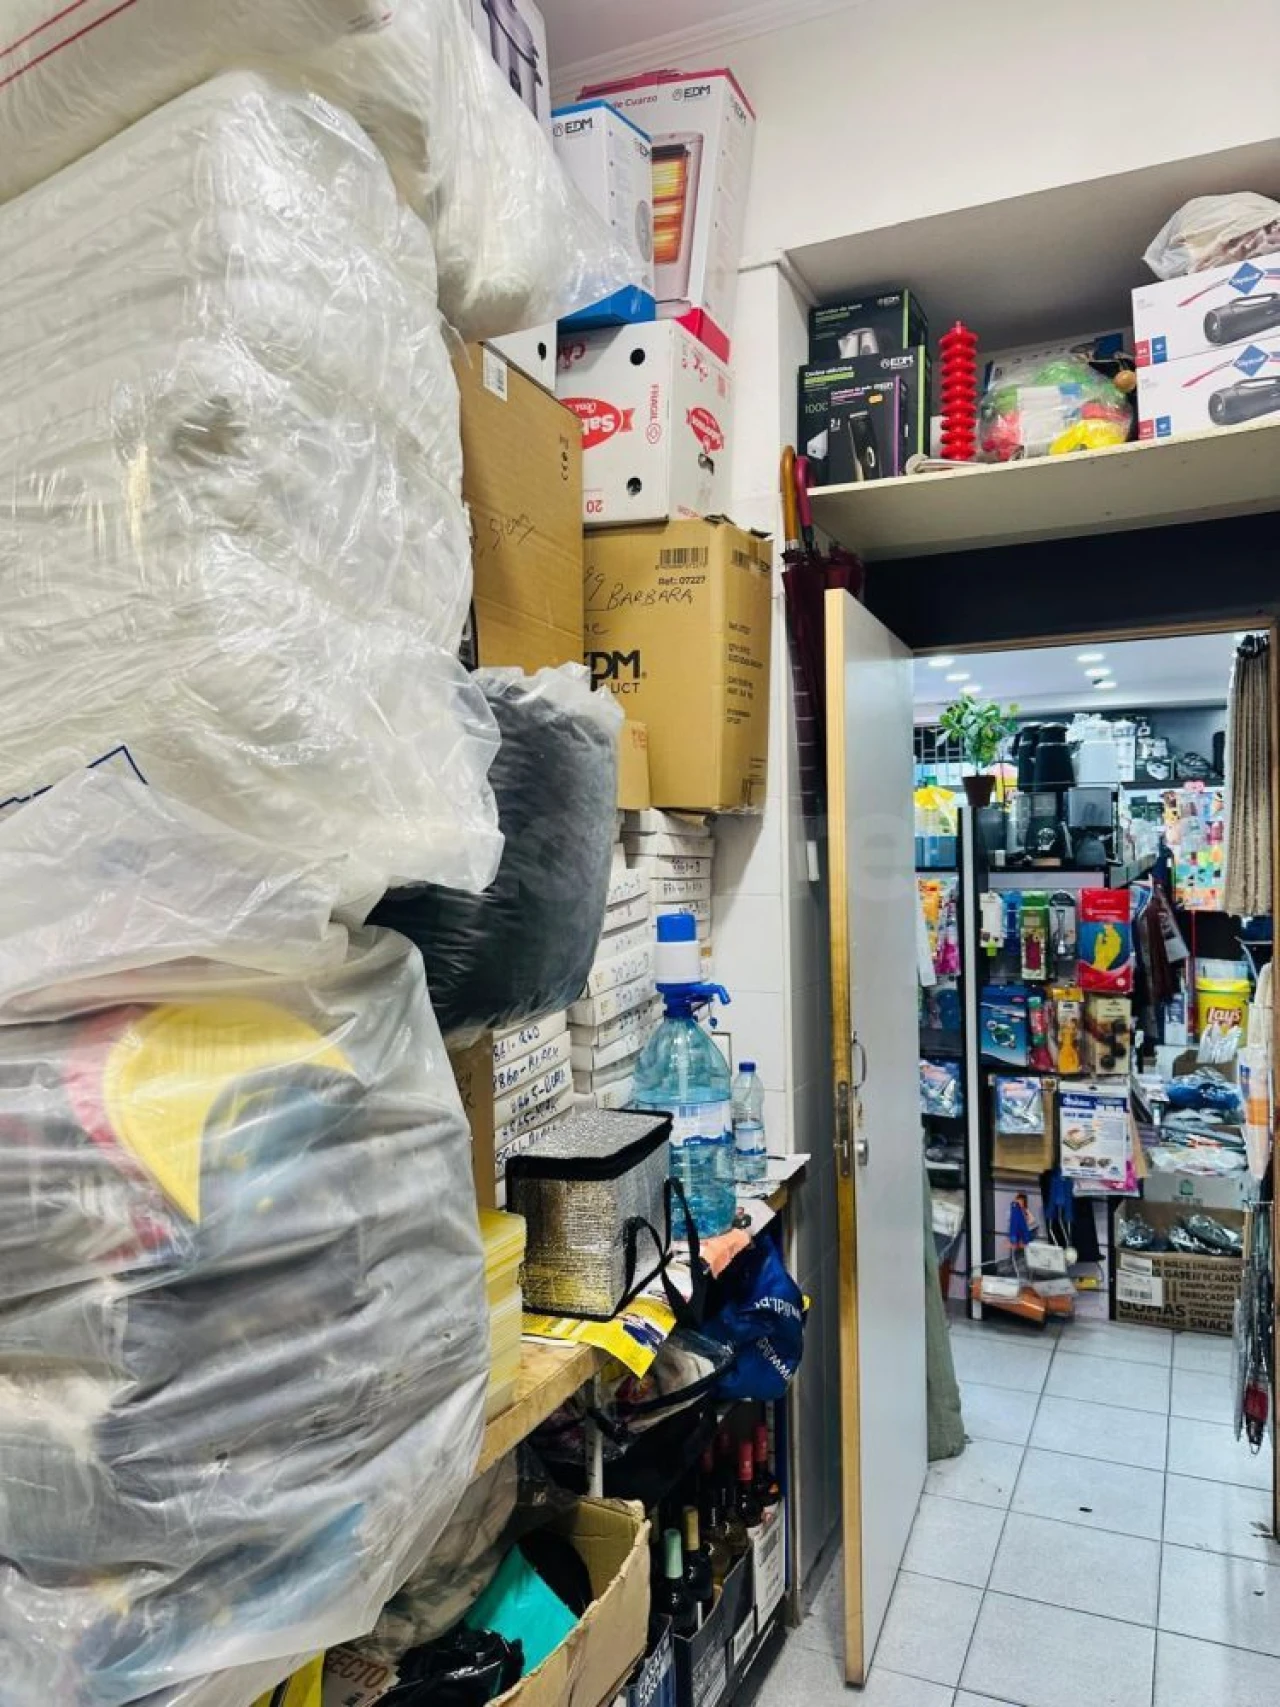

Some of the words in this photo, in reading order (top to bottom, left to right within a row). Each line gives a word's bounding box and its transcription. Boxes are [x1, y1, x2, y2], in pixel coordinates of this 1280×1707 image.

[683, 84, 712, 99] EDM
[624, 95, 658, 107] Cuarzo
[564, 117, 593, 134] EDM
[890, 354, 914, 368] EDM
[586, 500, 604, 513] 20
